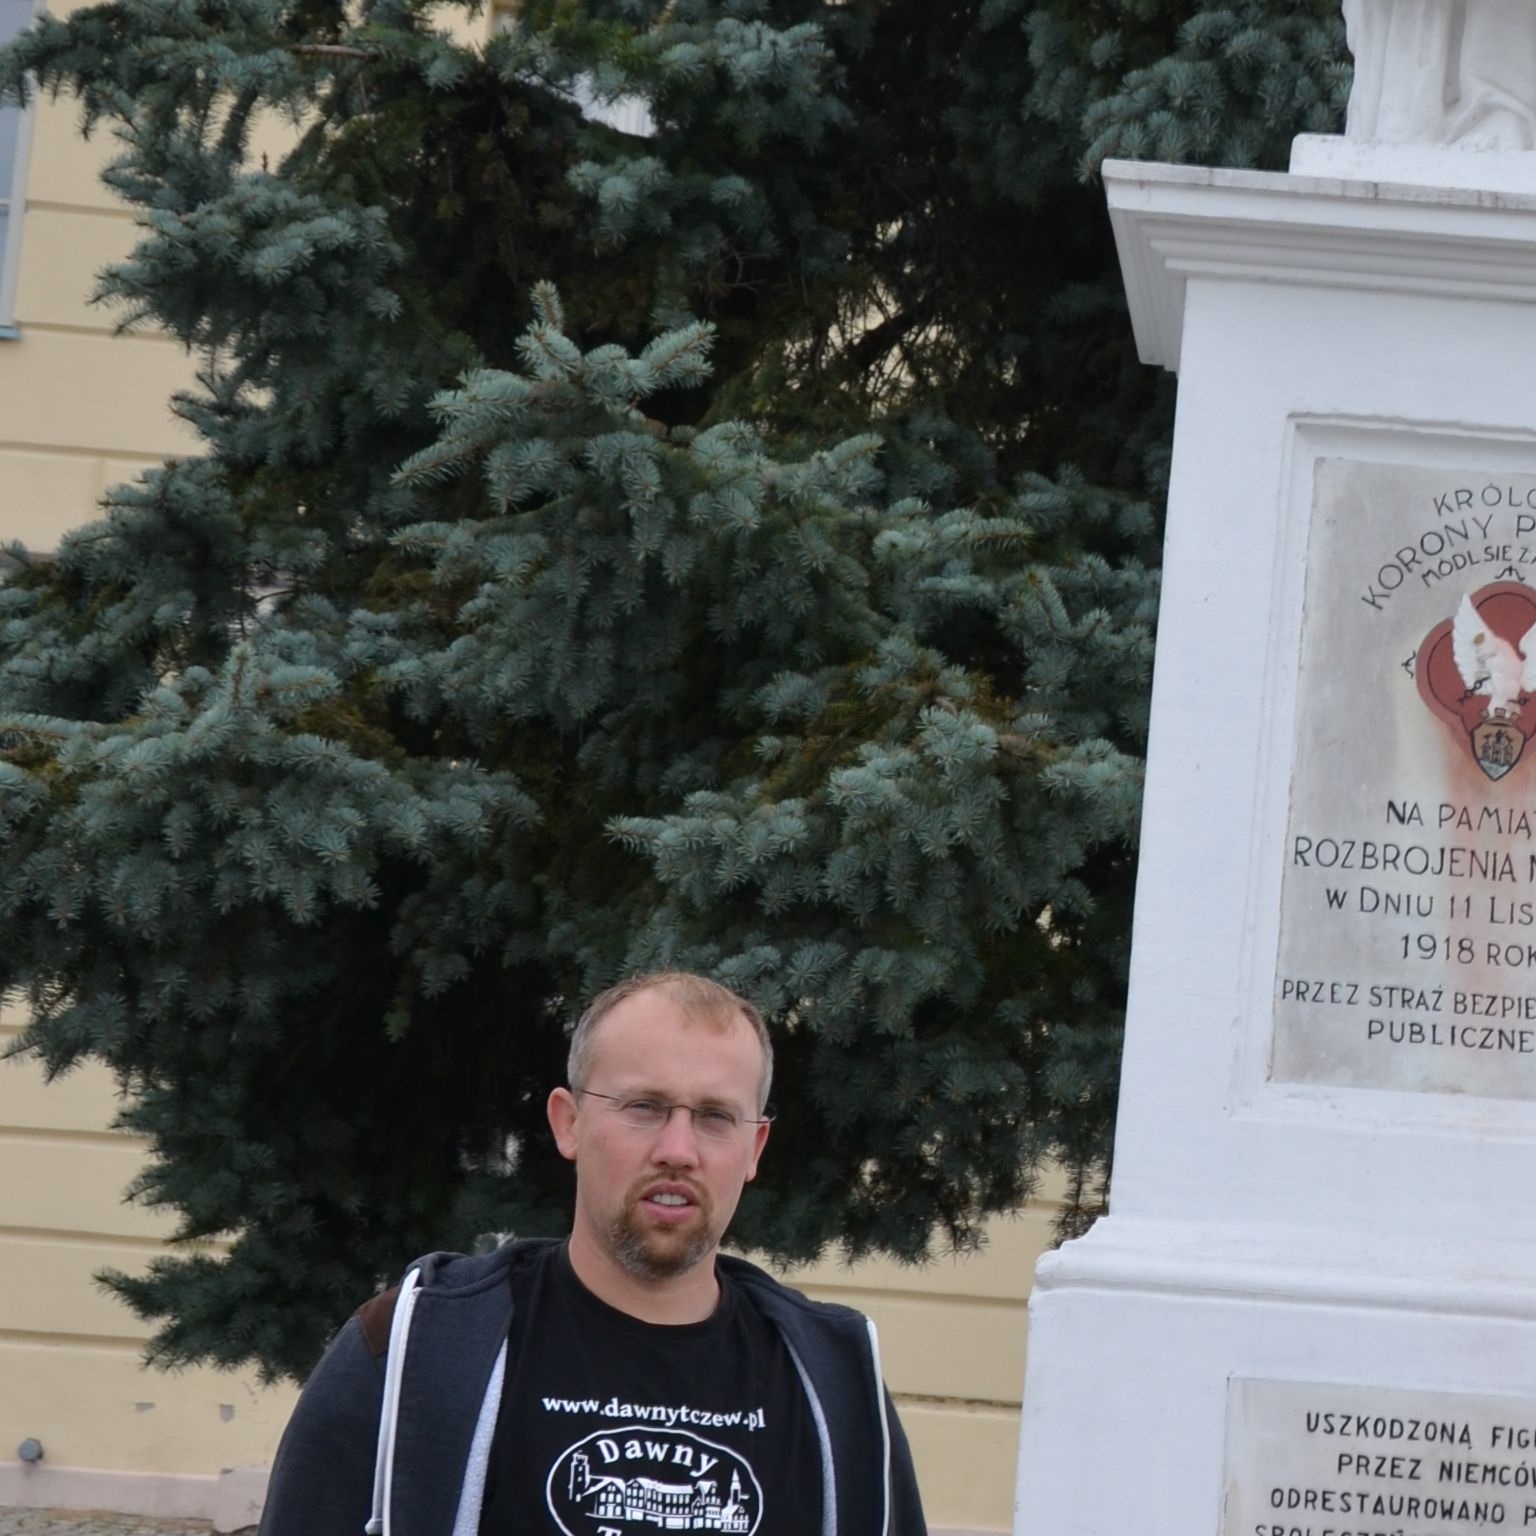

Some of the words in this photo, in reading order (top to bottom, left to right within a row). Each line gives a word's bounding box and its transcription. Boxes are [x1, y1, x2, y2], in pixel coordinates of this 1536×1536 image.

[1361, 514, 1494, 611] KORONY
[1386, 800, 1424, 827] NA
[1293, 836, 1517, 884] ROZBROJENIA
[1359, 886, 1434, 918] DNIU
[1448, 895, 1473, 920] 11
[1401, 934, 1475, 965] 1918
[1281, 979, 1360, 1006] PRZEZ
[1369, 984, 1444, 1013] STRAŻ
[542, 1395, 766, 1431] www.dawnytczew.pl
[1305, 1411, 1473, 1451] USZKODZONĄ
[596, 1437, 719, 1478] Dawny
[1337, 1452, 1423, 1481] PRZEZ
[1270, 1487, 1506, 1525] ODRESTAUROWANO
